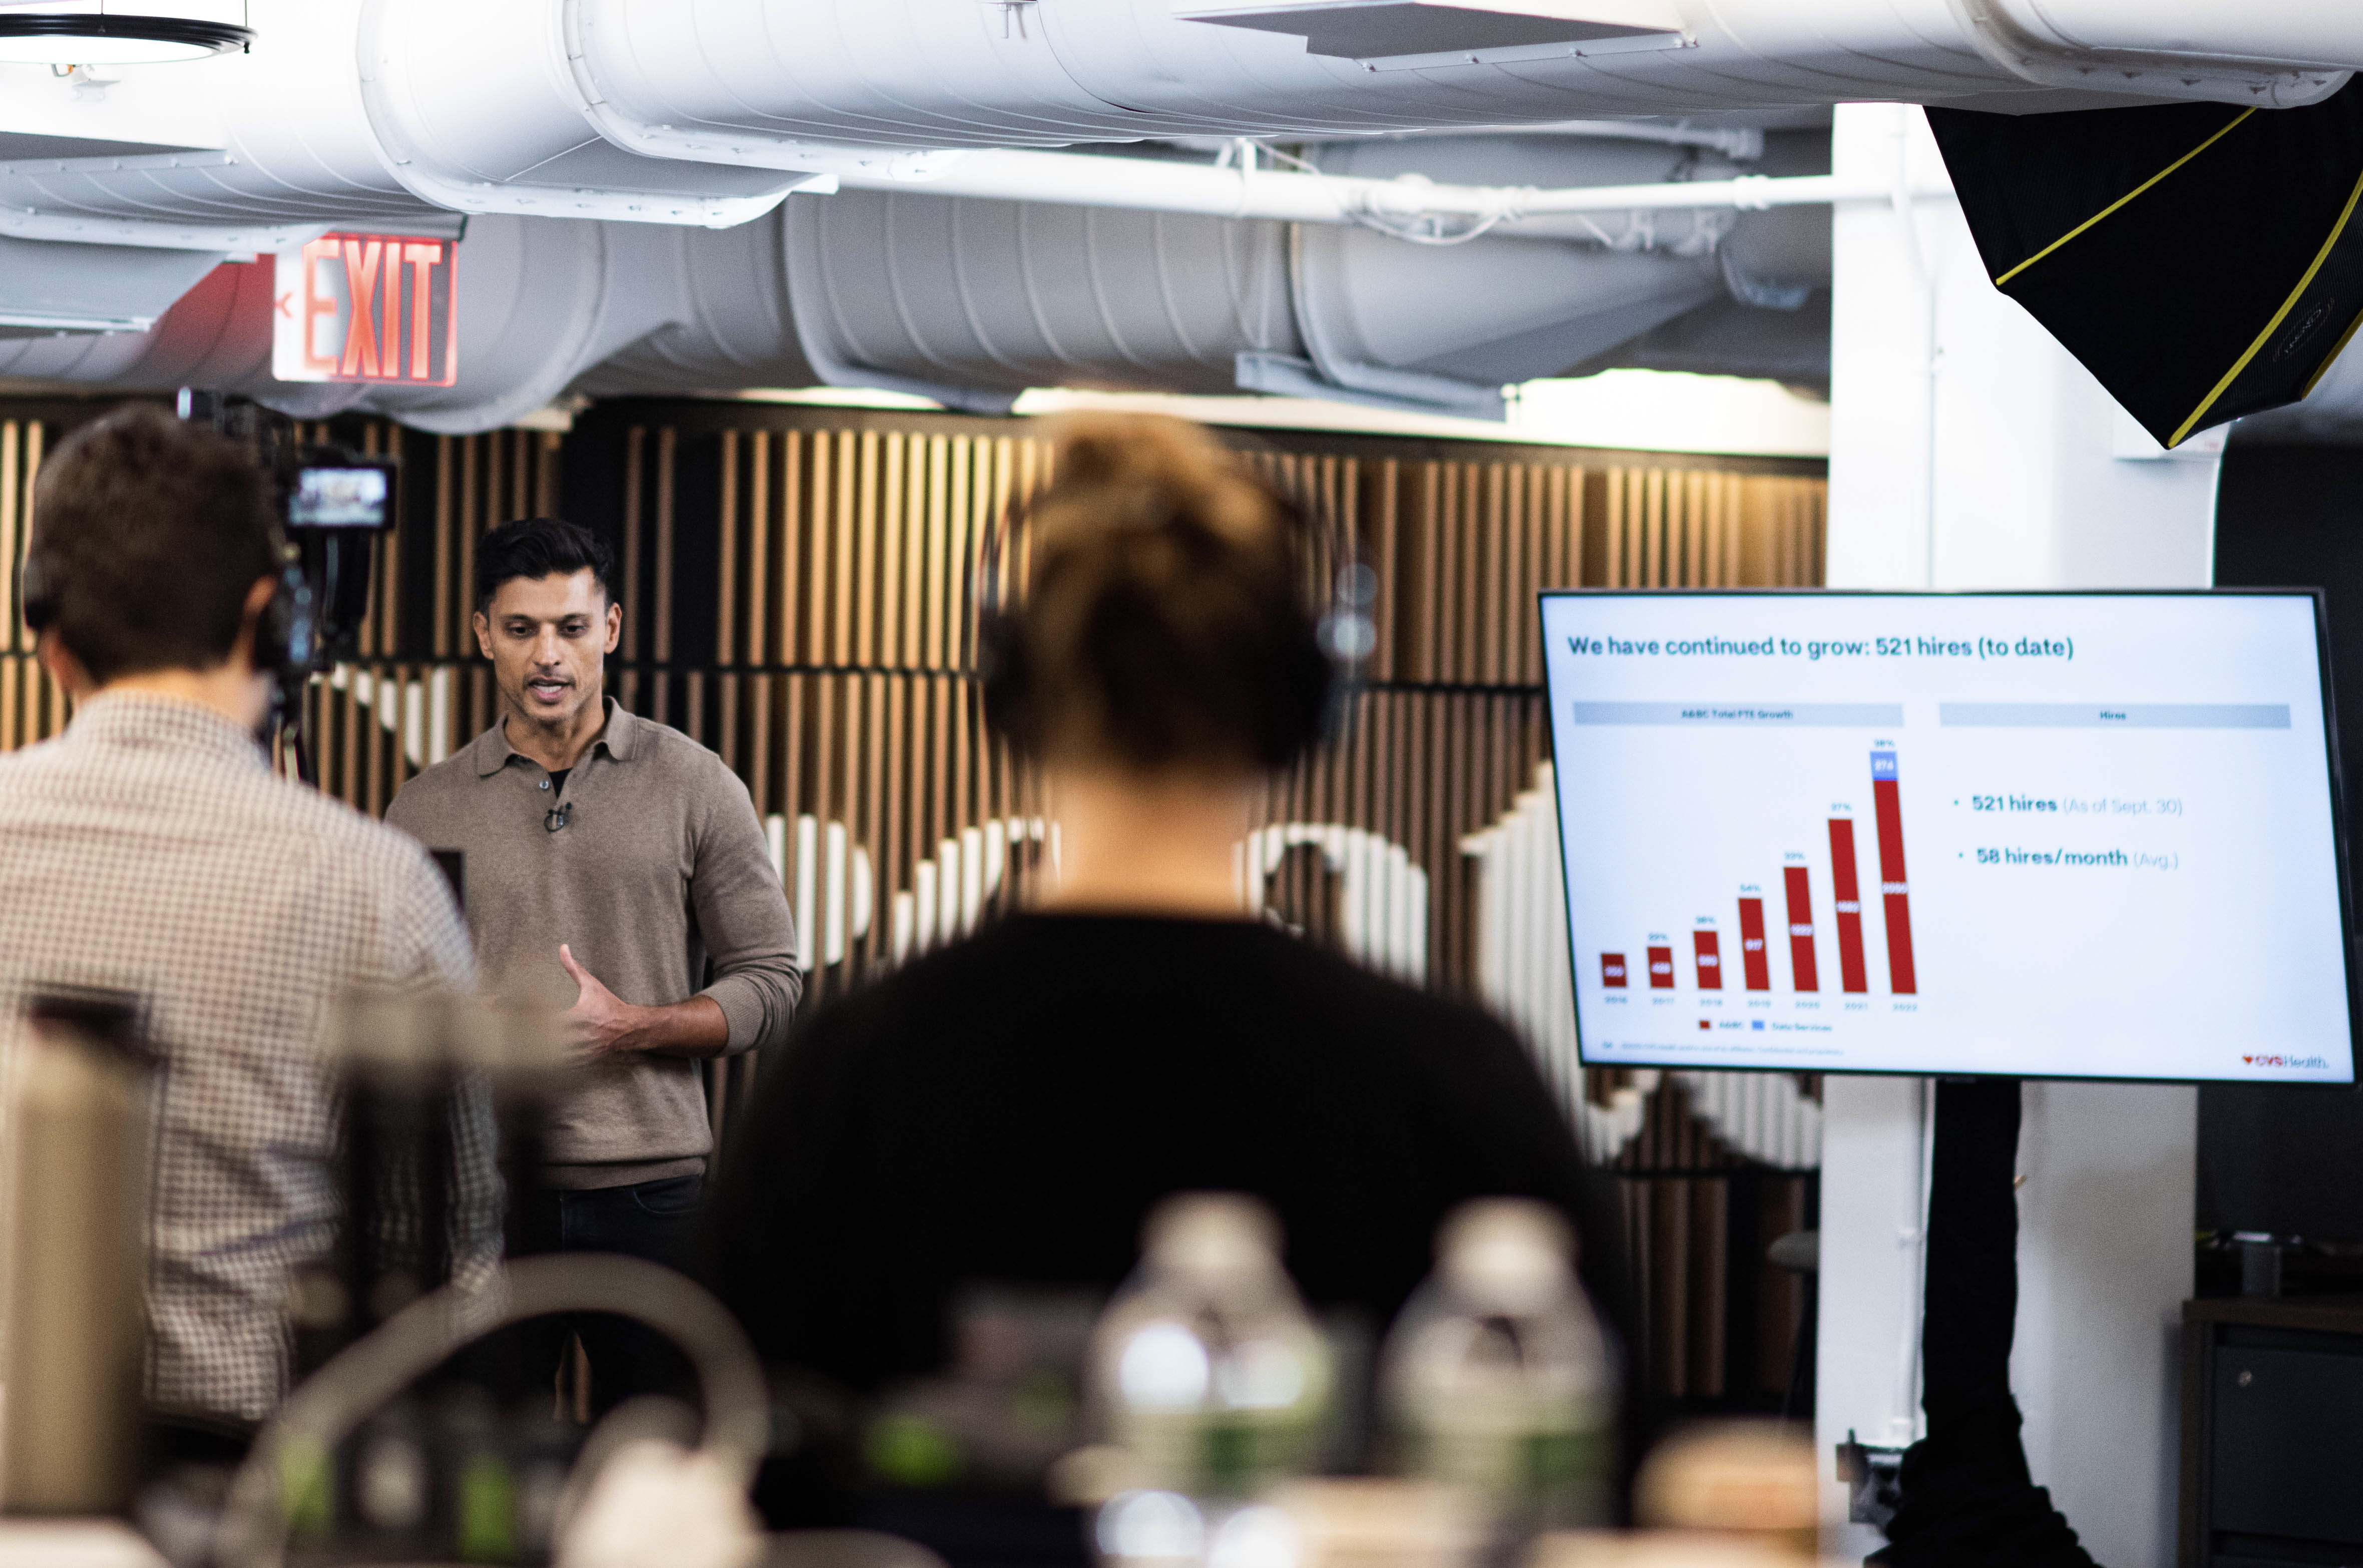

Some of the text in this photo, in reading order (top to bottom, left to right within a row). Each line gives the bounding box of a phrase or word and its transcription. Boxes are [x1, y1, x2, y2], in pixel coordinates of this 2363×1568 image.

[302, 238, 442, 380] EXIT
[1567, 636, 2074, 660] We have continued to grow: 521 hires (to date)
[1712, 709, 1736, 719] Total
[1757, 709, 1793, 719] Growth
[2100, 711, 2126, 720] Hires
[1972, 794, 2183, 817] 521 hires (As of Sept. 30)
[1977, 847, 2179, 871] 58 hires/month (Avg.)
